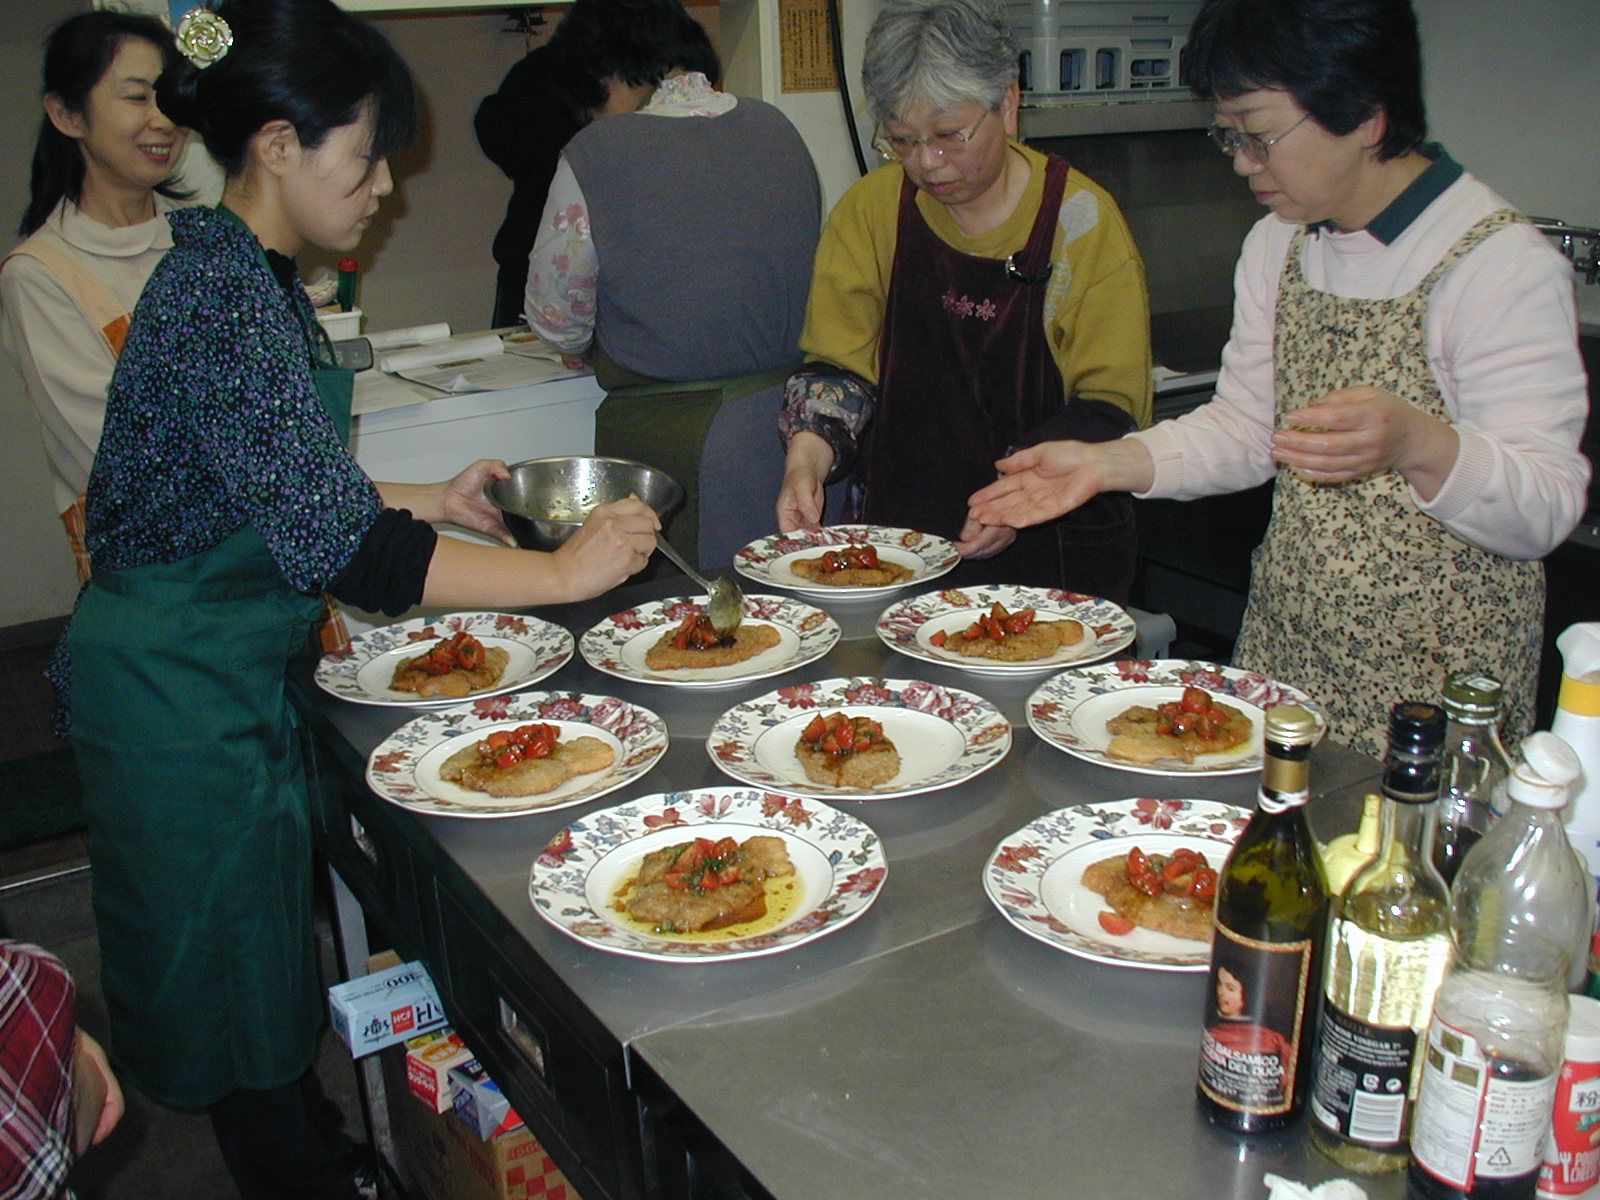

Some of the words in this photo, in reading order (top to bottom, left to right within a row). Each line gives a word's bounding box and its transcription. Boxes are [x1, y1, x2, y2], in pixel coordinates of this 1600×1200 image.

[1353, 1033, 1391, 1049] VINEGAR
[1214, 1041, 1279, 1066] BALSAMICO
[1227, 1058, 1250, 1075] DEL
[1252, 1064, 1285, 1077] DUCA
